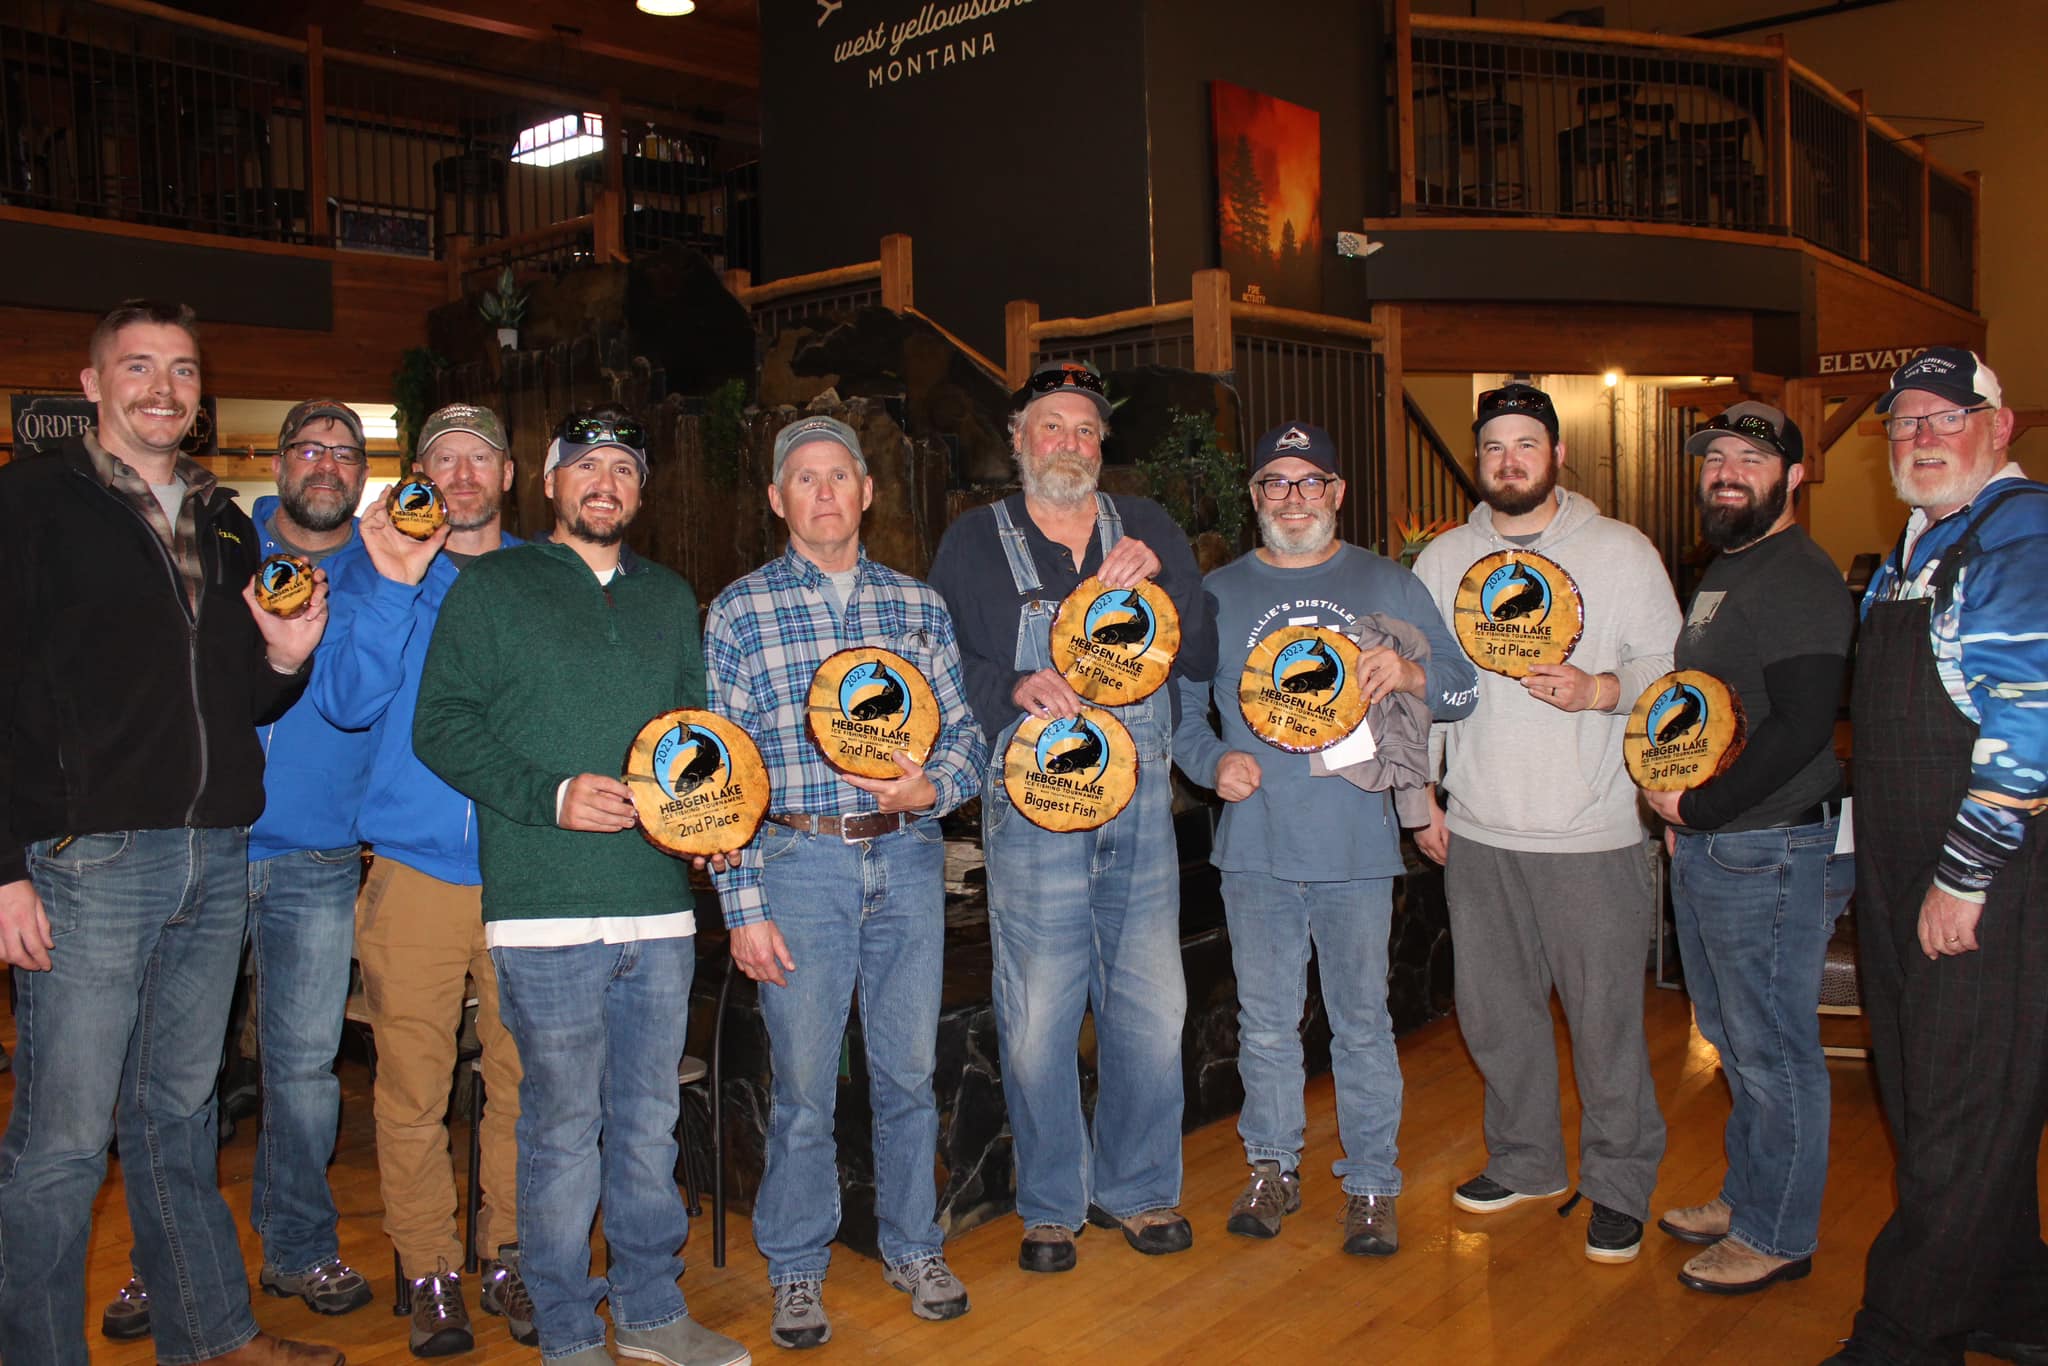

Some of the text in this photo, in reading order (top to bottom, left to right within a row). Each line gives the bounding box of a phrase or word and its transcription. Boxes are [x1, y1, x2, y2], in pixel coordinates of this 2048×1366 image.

[834, 22, 886, 63] west
[868, 32, 996, 88] MONTANA
[25, 414, 91, 439] ORDER
[1487, 569, 1507, 590] 2023
[1091, 594, 1113, 615] 2023
[1246, 603, 1291, 648] WILLIE'S
[1475, 622, 1552, 636] HEBGEN LAKE
[1071, 635, 1115, 661] HEBGEN
[1116, 655, 1144, 673] LAKE
[1281, 643, 1304, 661] 2023
[1486, 642, 1541, 658] 3rd Place
[845, 667, 866, 688] 2023
[1075, 662, 1091, 677] 1st
[1091, 668, 1123, 689] Place
[1260, 687, 1306, 708] HEBGEN
[1308, 702, 1336, 719] LAKE
[1653, 694, 1669, 716] 2023
[831, 718, 911, 742] HEBGEN LAKE
[1267, 711, 1283, 726] 1st
[1284, 716, 1317, 737] Place
[656, 738, 674, 765] 2023
[840, 740, 863, 756] 2nd
[865, 745, 894, 762] Plac
[1641, 738, 1708, 759] HEBGEN LAKE
[1026, 771, 1072, 788] HEBGEN
[1075, 781, 1104, 795] LAKE
[1650, 763, 1698, 780] 3rd Place
[660, 793, 709, 815] HEBGEN
[711, 784, 742, 801] LAKE
[1024, 792, 1070, 812] Biggest
[1072, 802, 1097, 819] Fish
[678, 819, 704, 838] 2nd
[704, 813, 740, 830] Place
